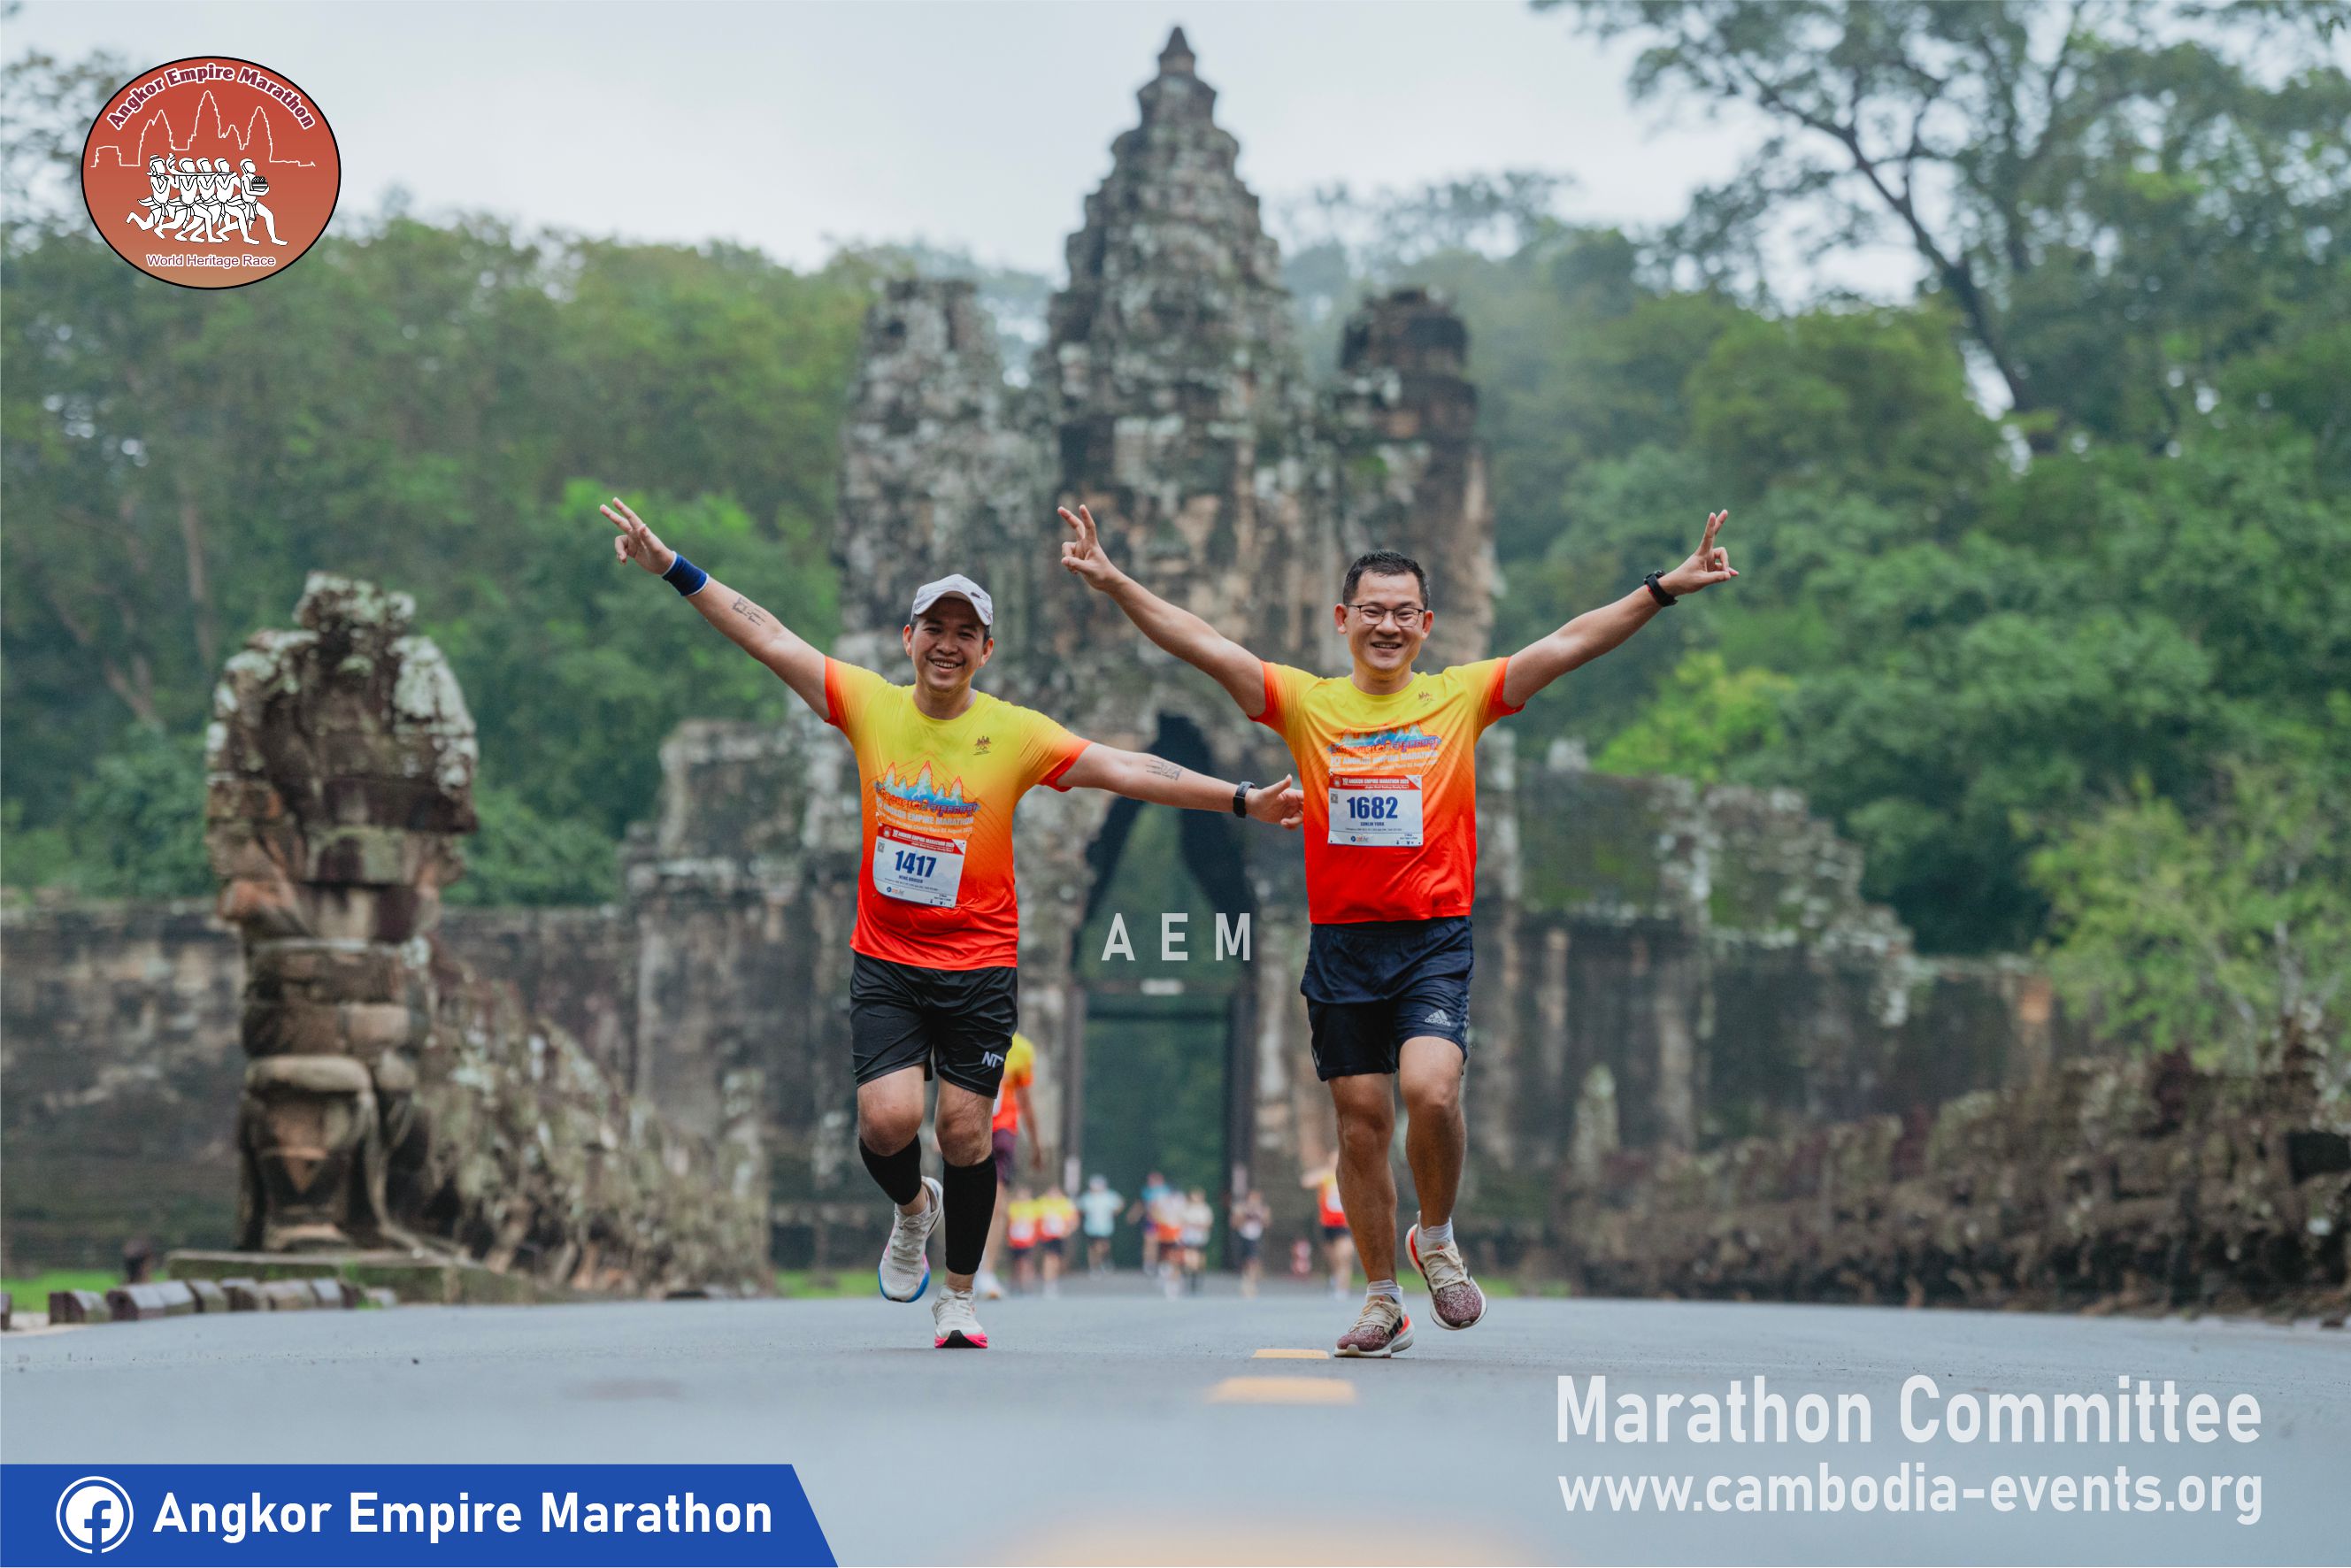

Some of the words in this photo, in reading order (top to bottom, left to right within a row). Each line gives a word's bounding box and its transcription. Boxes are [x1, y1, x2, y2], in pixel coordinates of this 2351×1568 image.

[907, 812, 934, 824] EMPIRE
[935, 816, 974, 826] MARATHON
[1347, 796, 1398, 819] 1682
[895, 849, 937, 878] 1417
